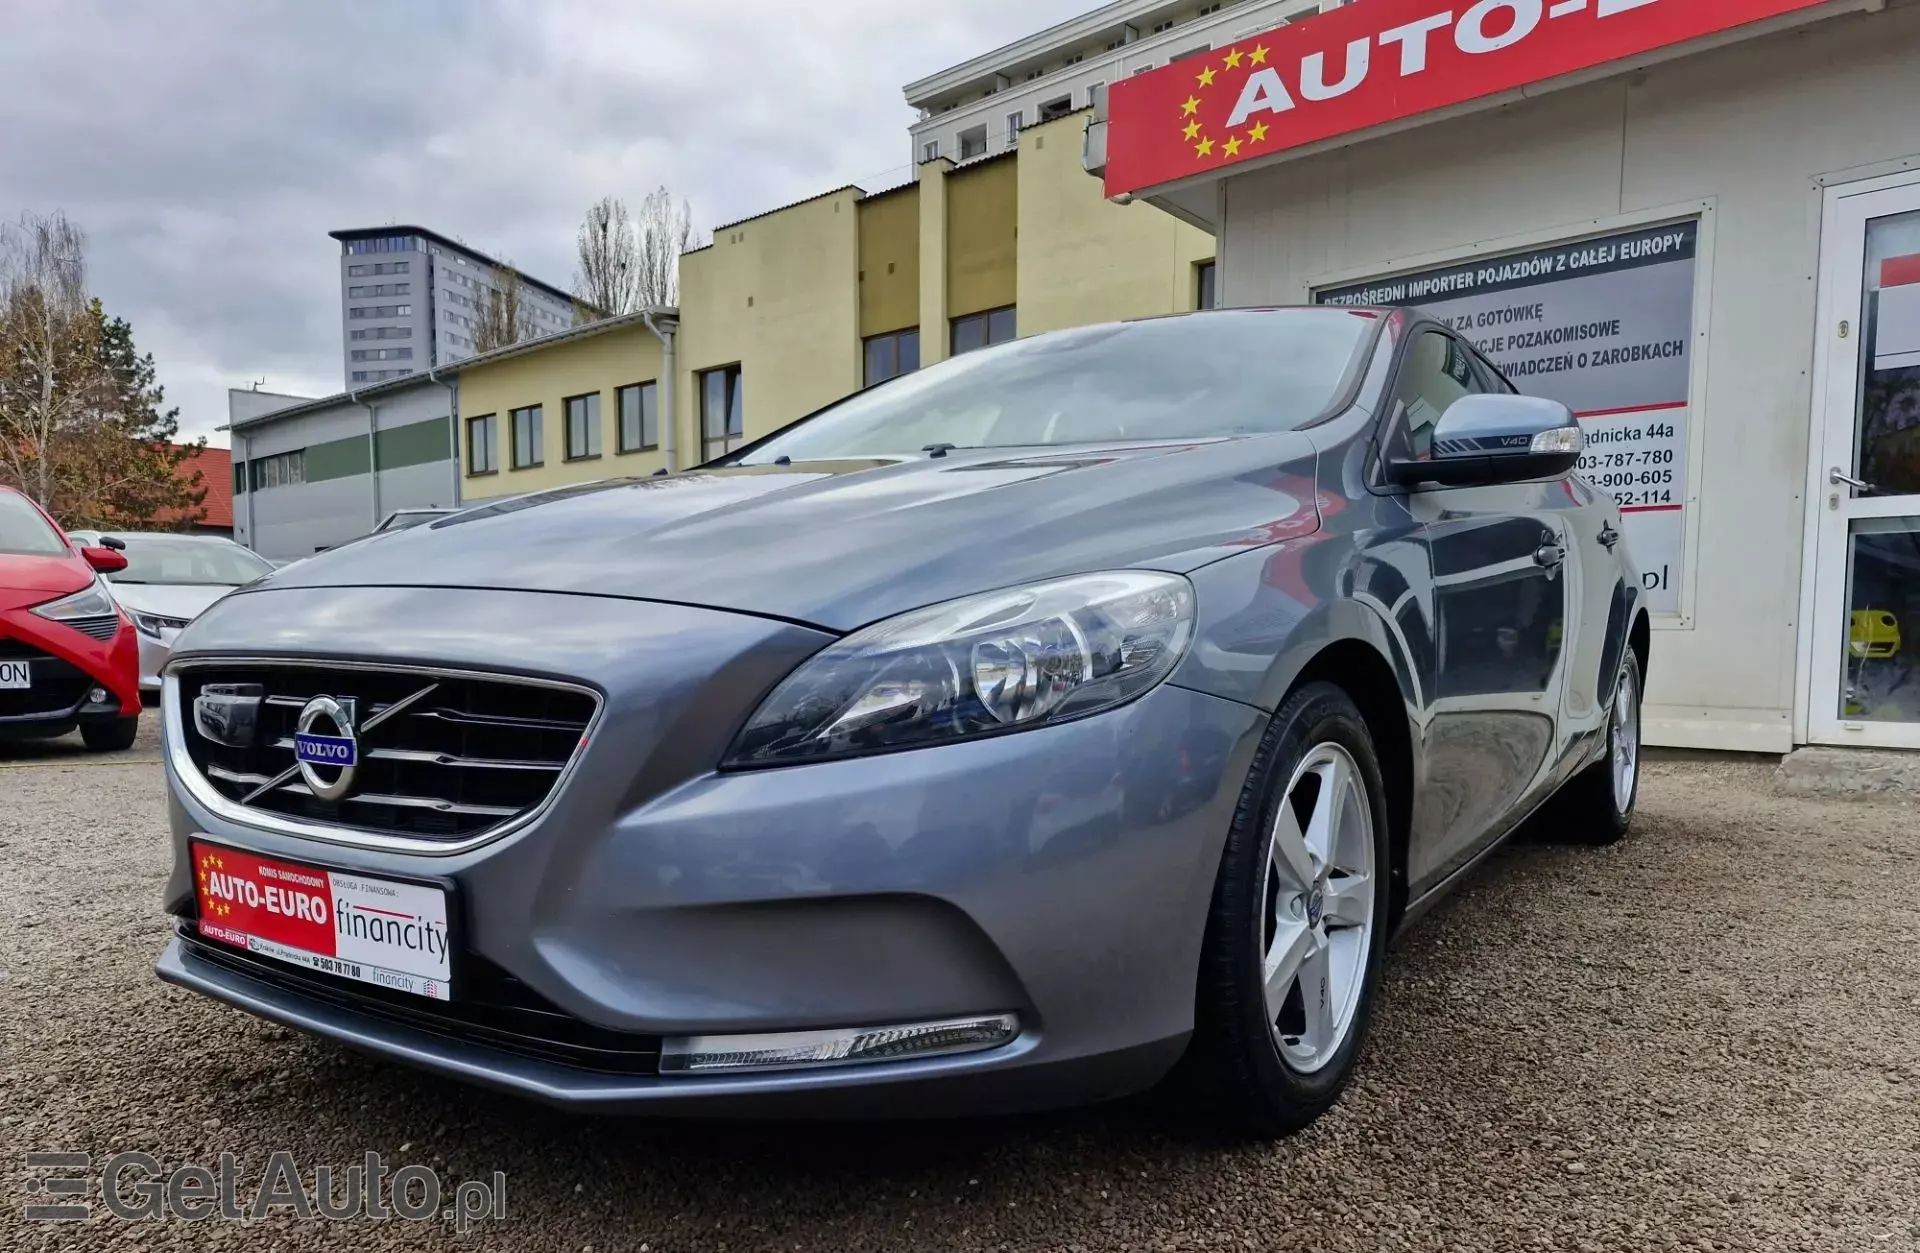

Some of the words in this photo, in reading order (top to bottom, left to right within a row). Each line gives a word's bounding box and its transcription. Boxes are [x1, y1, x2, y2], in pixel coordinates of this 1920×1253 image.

[1409, 271, 1474, 297] IMPORTER
[1477, 254, 1553, 286] POJAZDÓW
[1555, 254, 1566, 272] Z
[1569, 244, 1616, 269] CAŁEJ
[1620, 232, 1684, 259] EUROPY
[1456, 314, 1473, 331] ZA
[1477, 303, 1544, 328] GOTÓWKĘ
[1507, 319, 1621, 350] POZAKOMISOWE
[1577, 352, 1588, 369] O
[1591, 339, 1684, 367] ZAROBKACH
[1500, 436, 1528, 447] V40
[1584, 426, 1642, 448] ądnicka
[1646, 423, 1674, 439] 44a
[1573, 449, 1673, 470] 03-787-780
[1580, 469, 1673, 487] 3-900-605
[1614, 489, 1671, 506] 52-114
[297, 740, 349, 759] VOLVO
[258, 865, 277, 879] KOMIS
[278, 869, 325, 888] SAMOCHODOWY
[209, 871, 327, 925] AUTO-EURO
[203, 924, 246, 945] AUTO-EURO
[336, 898, 449, 964] financity
[320, 957, 333, 971] 503
[351, 965, 361, 978] 80
[373, 966, 414, 993] financity
